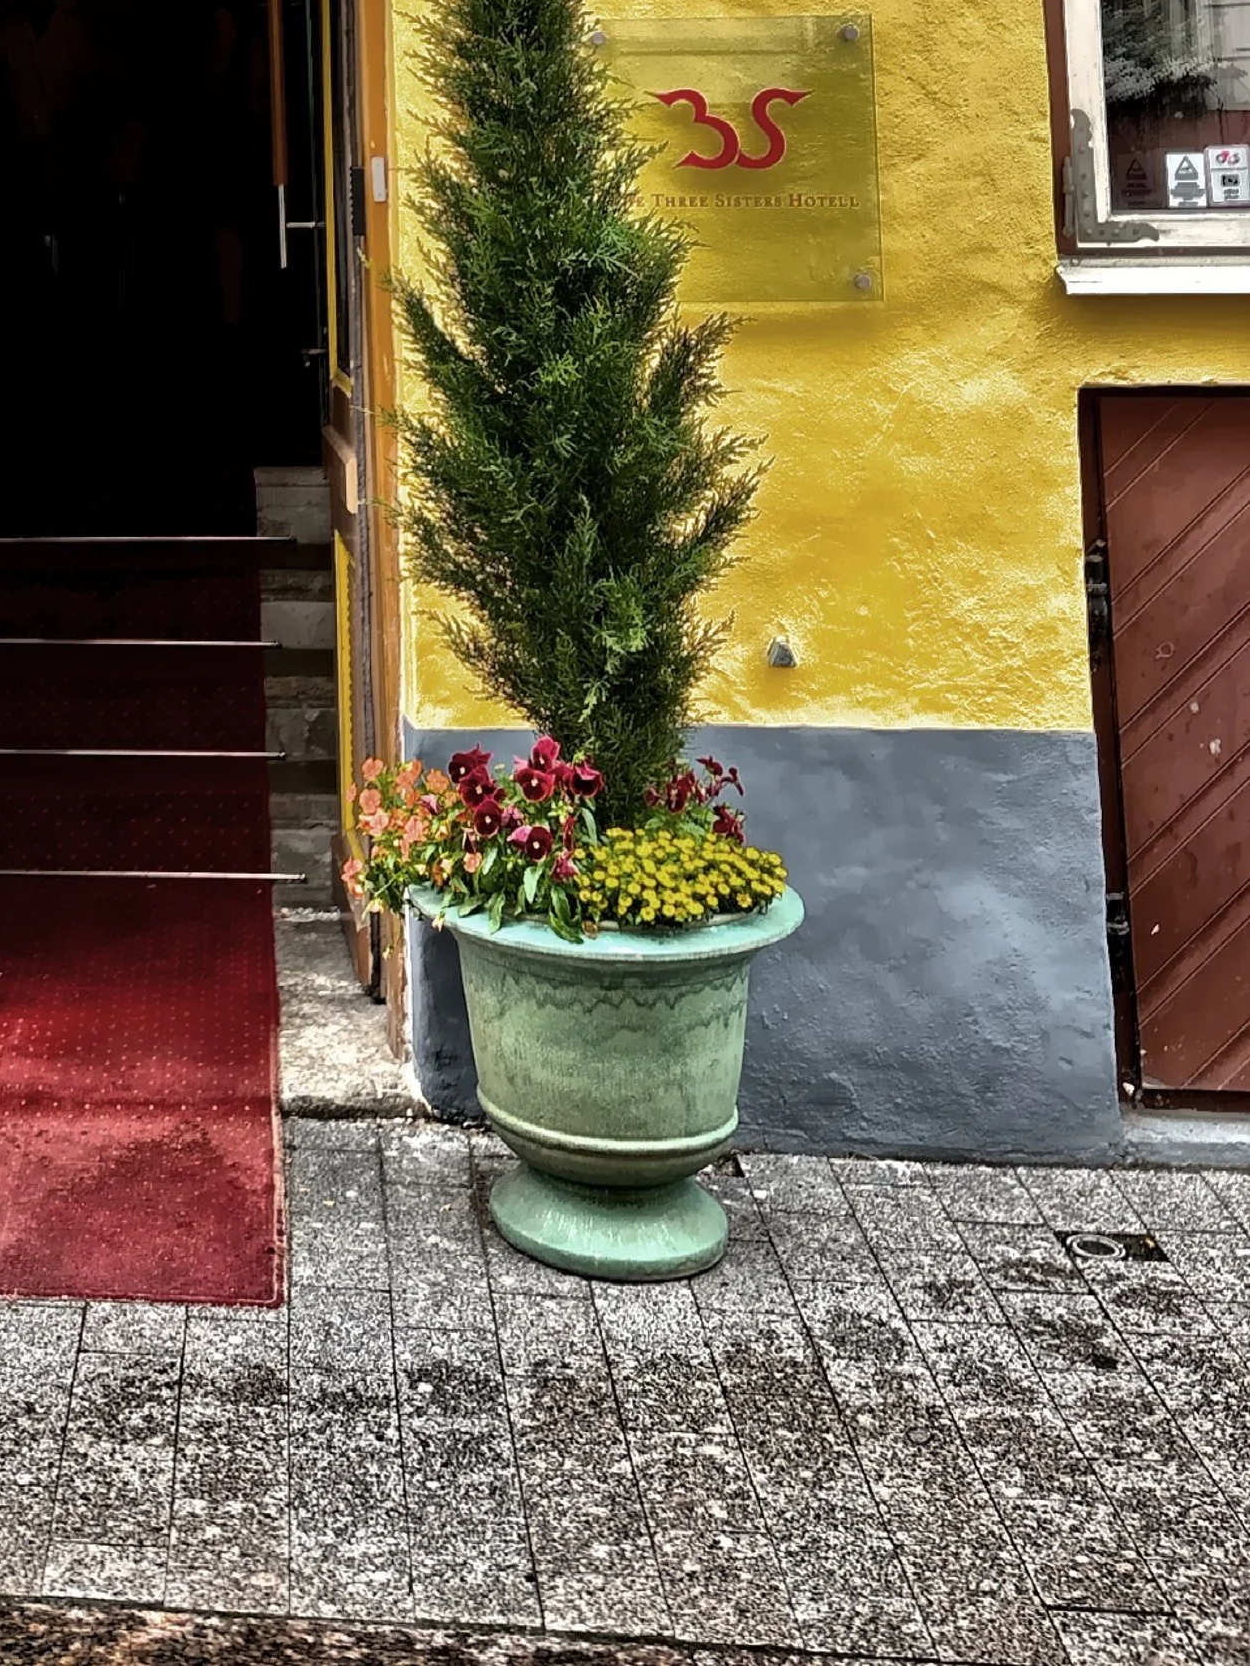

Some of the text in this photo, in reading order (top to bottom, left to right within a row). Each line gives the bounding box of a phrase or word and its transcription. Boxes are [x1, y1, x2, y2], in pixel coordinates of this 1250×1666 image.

[651, 193, 708, 208] THREE
[715, 193, 783, 209] SISTERS
[789, 193, 860, 209] HOTELL
